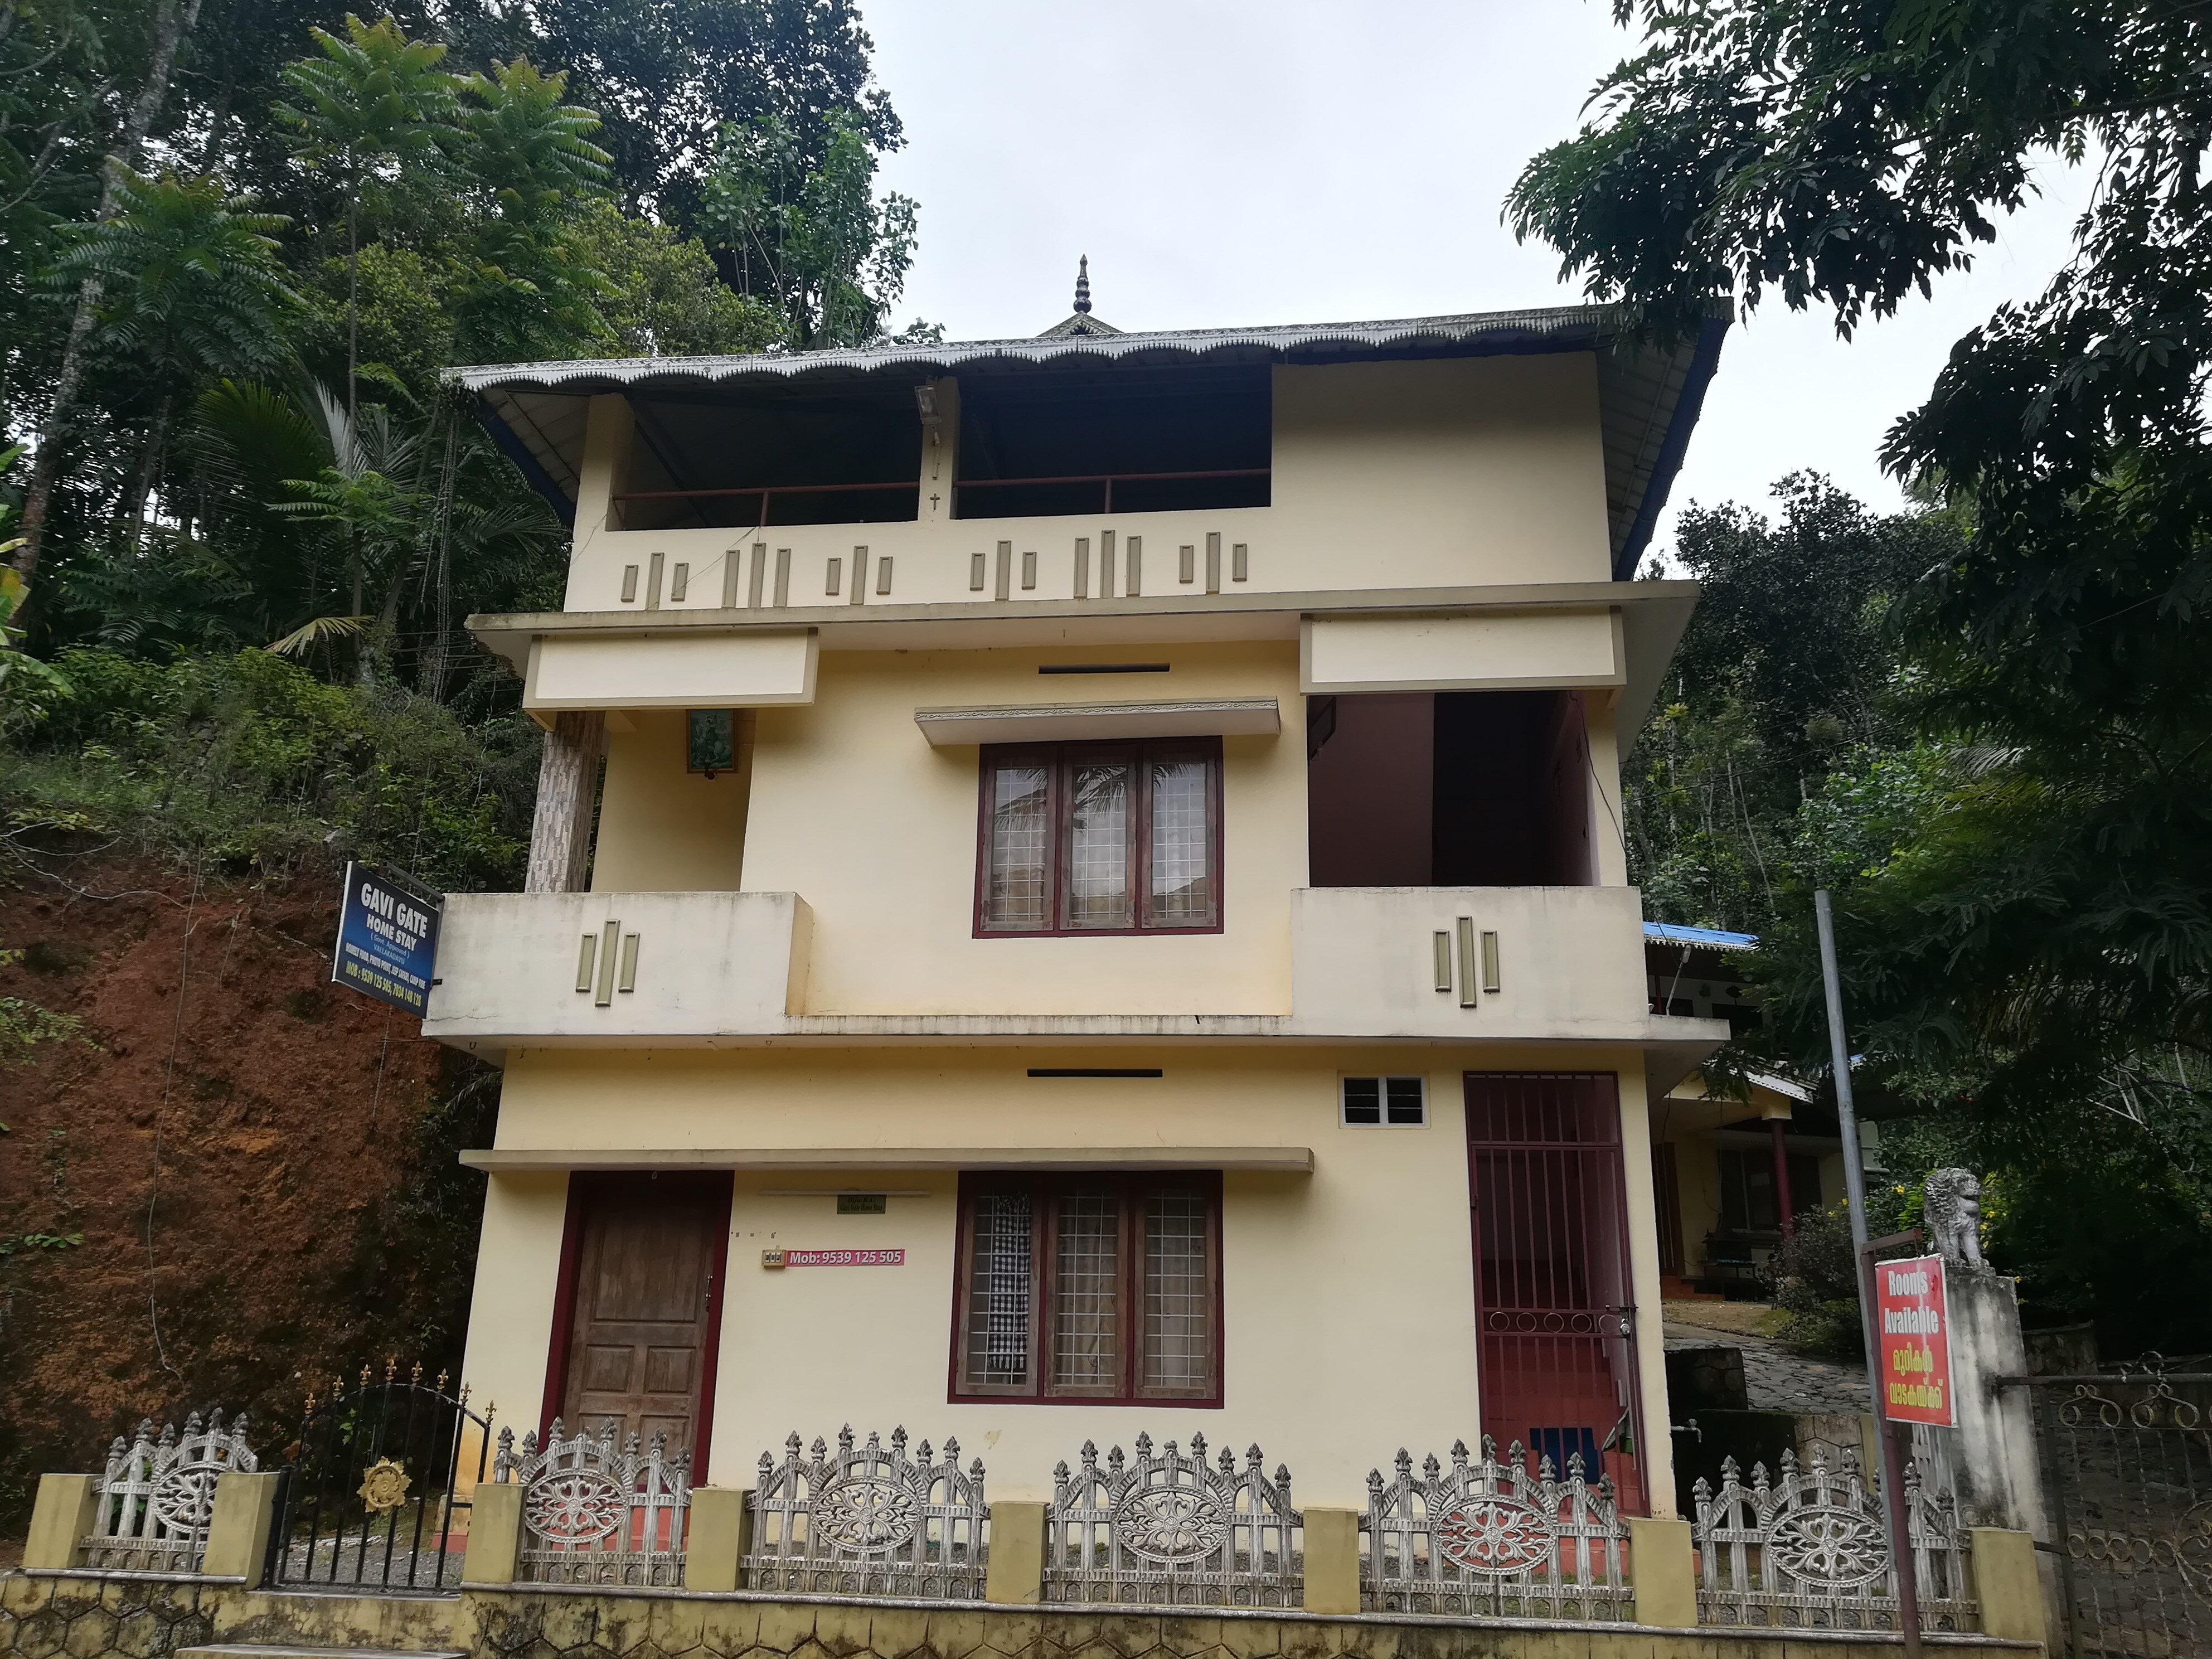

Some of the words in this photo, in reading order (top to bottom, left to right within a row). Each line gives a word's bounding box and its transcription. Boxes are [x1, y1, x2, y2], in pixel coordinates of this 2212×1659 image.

[361, 882, 394, 920] GAVI
[396, 903, 428, 939] GATE
[366, 913, 395, 940] HOME
[395, 930, 417, 951] STAY
[373, 944, 405, 964] VALLAKADAVU
[369, 954, 381, 968] PHOTO
[391, 964, 399, 976] JEEP
[410, 974, 419, 987] CAMP
[361, 968, 373, 984] 9539
[373, 974, 382, 989] 125
[392, 983, 404, 999] 7034
[404, 988, 413, 1003] 148
[413, 992, 421, 1007] 128
[790, 1252, 820, 1264] Mob:
[822, 1251, 852, 1264] 9539
[855, 1251, 876, 1263] 125
[879, 1251, 901, 1263] 505
[1888, 1270, 1929, 1296] Rooms
[1884, 1306, 1939, 1334] Available
